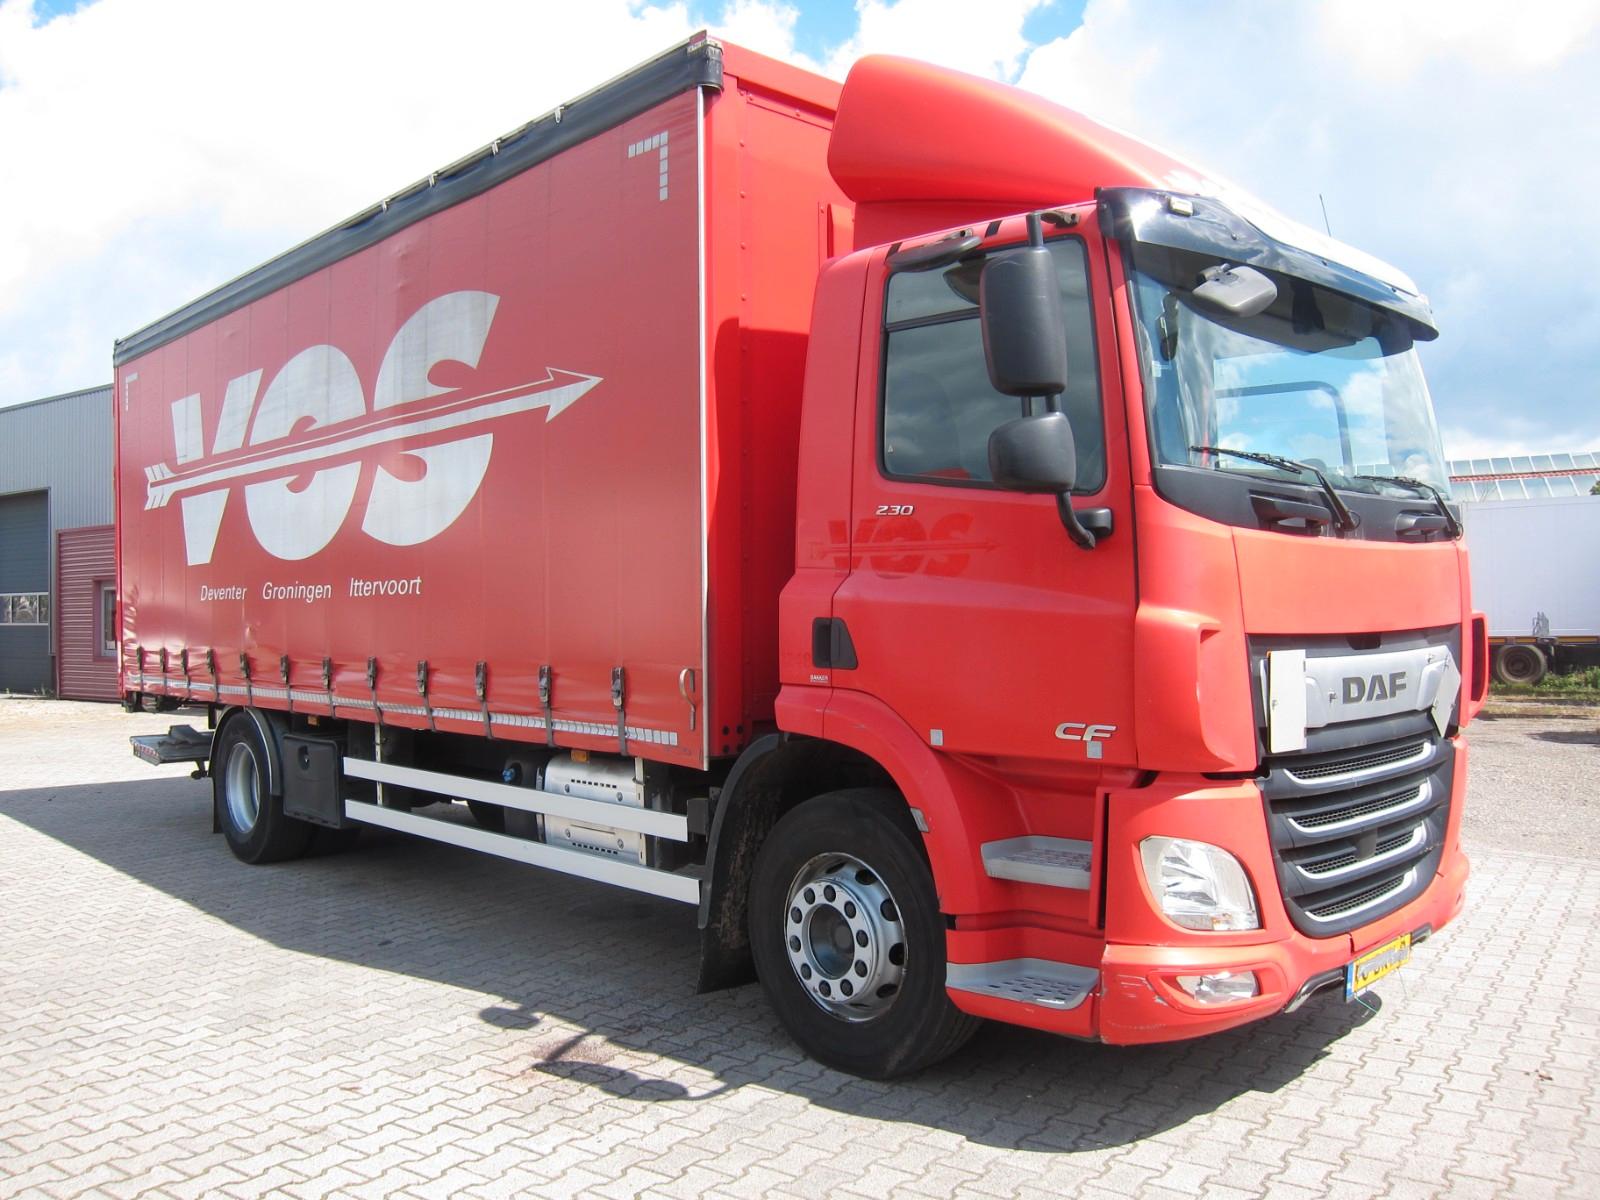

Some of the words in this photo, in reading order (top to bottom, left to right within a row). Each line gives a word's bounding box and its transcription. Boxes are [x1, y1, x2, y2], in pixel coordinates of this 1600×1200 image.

[171, 290, 501, 566] VOS
[875, 505, 914, 516] 230
[828, 513, 974, 579] VOS
[200, 585, 247, 601] Deventer
[262, 581, 332, 603] Groningen
[349, 576, 422, 597] Ittervoort
[1342, 671, 1407, 705] DAF
[1054, 722, 1117, 741] CF
